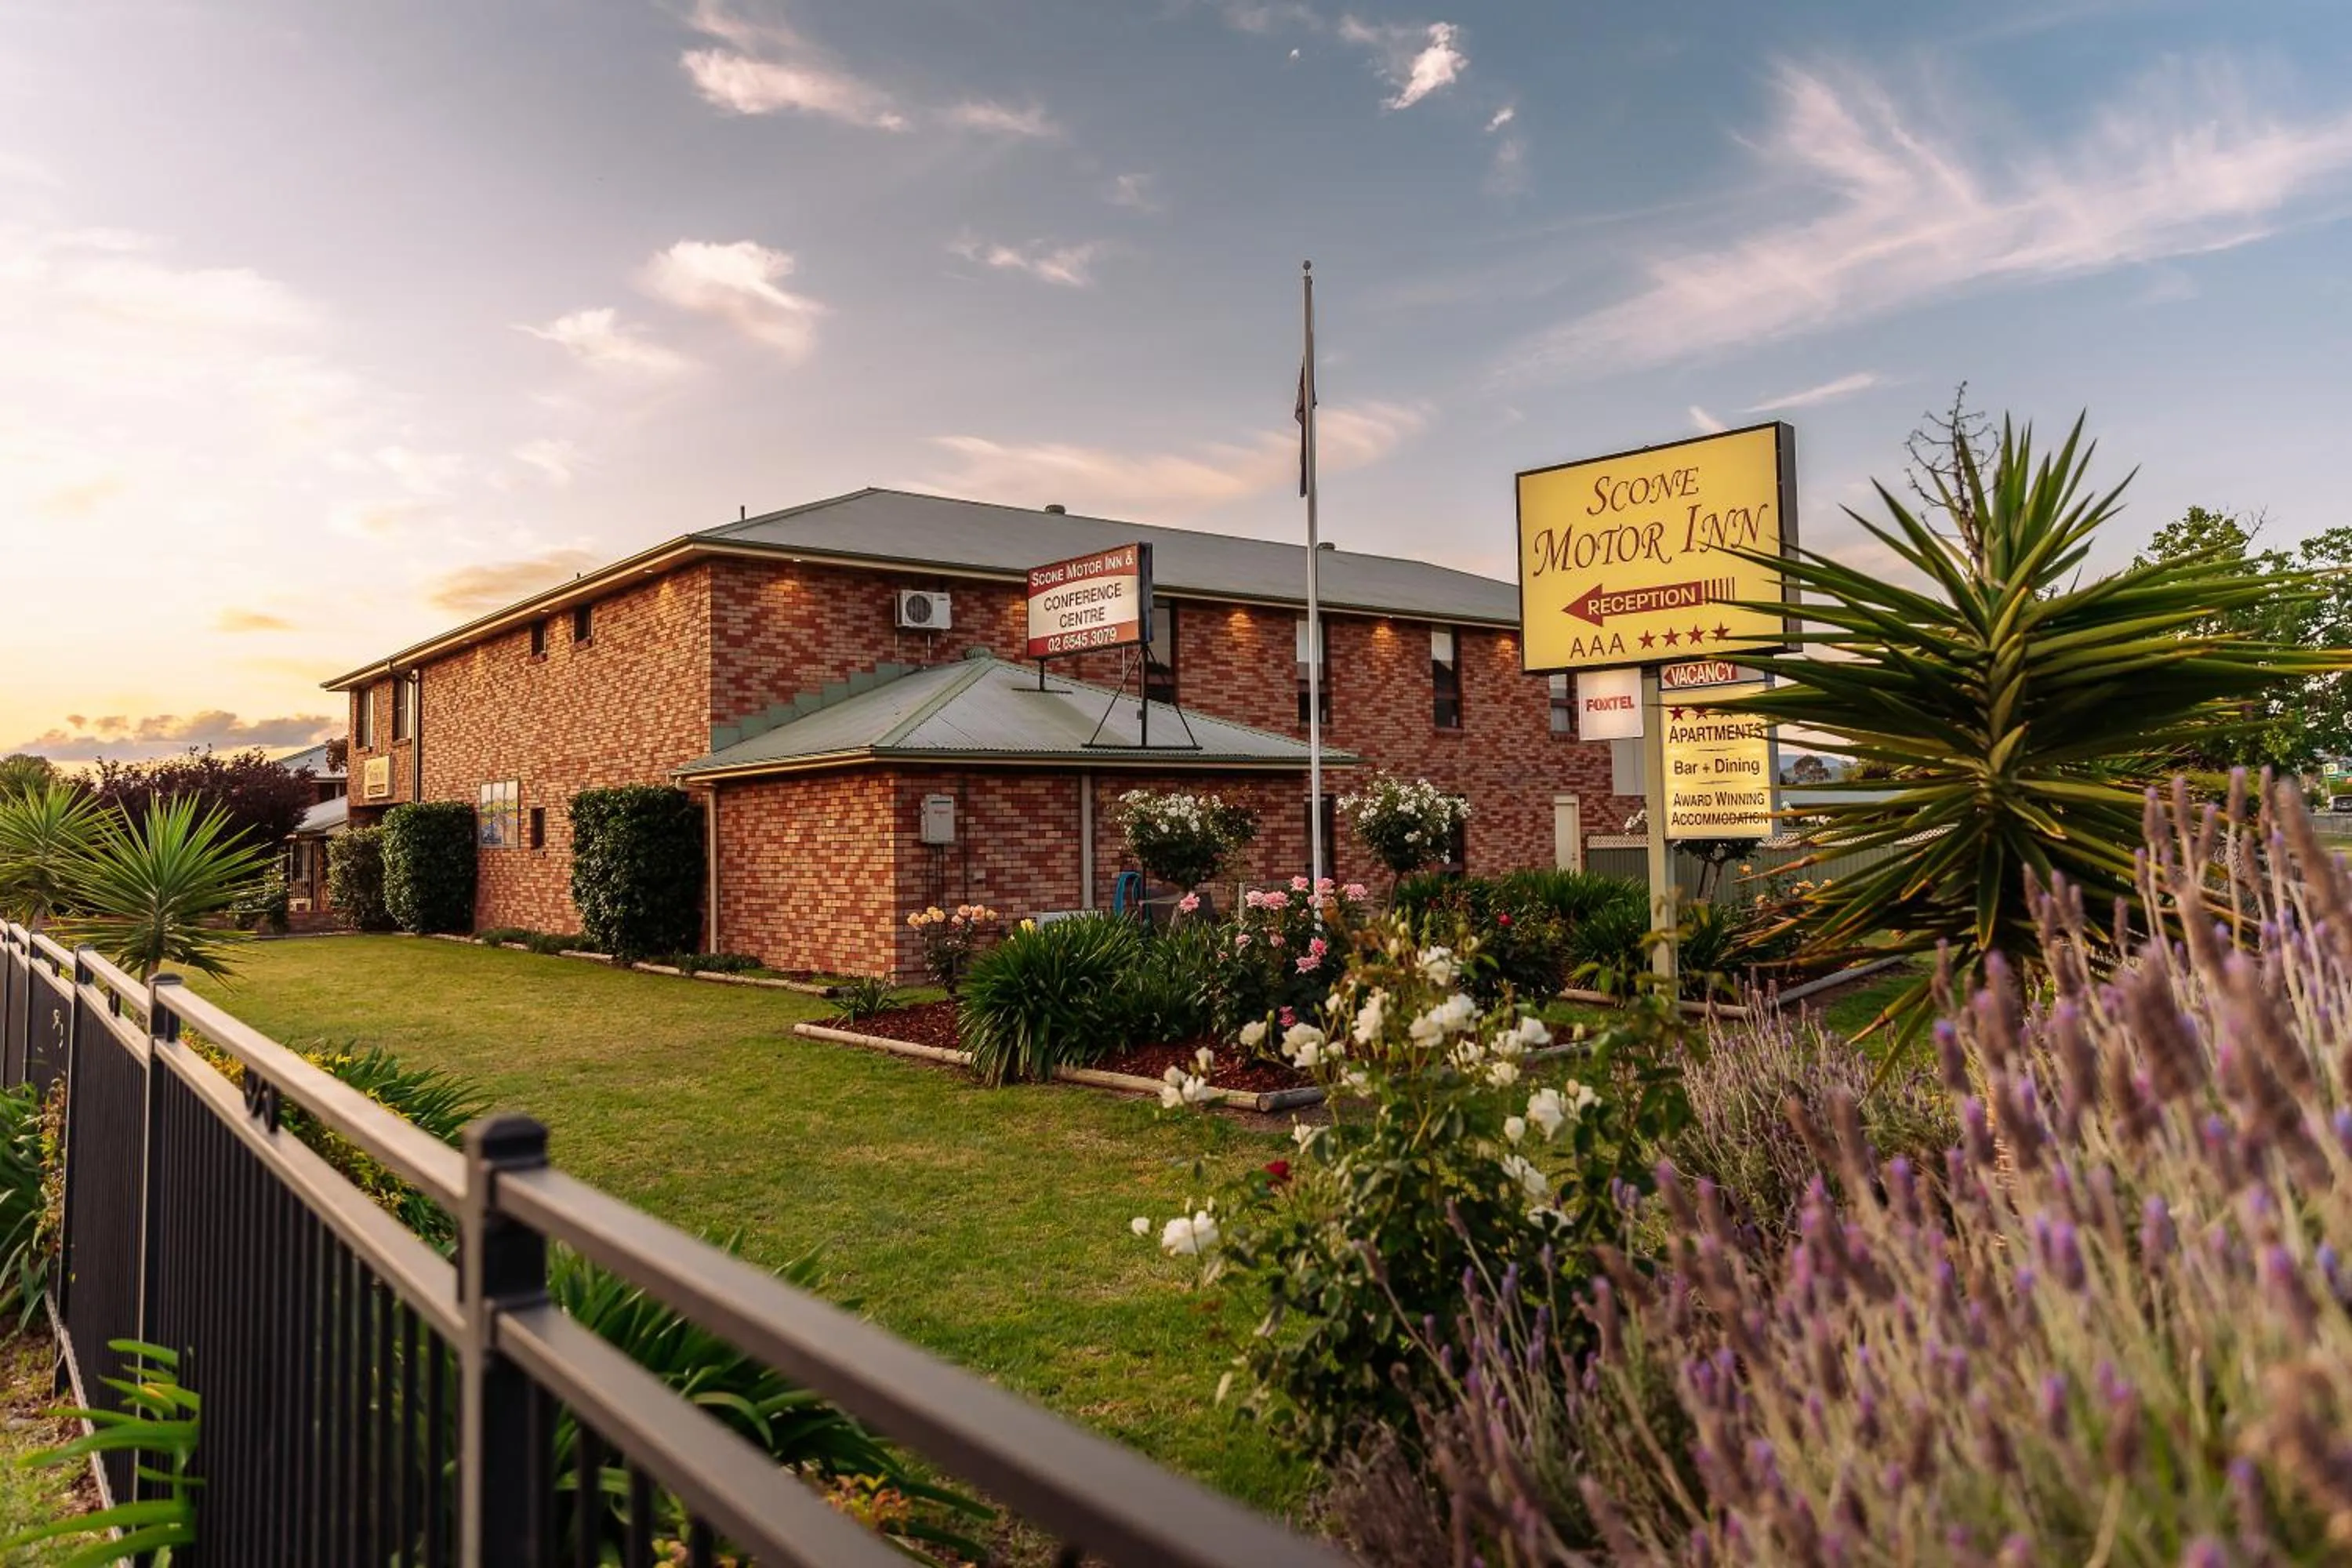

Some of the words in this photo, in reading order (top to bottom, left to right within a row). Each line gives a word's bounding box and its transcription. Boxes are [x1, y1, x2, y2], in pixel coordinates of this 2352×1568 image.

[1586, 467, 1700, 516] SCONE
[1533, 522, 1672, 577] MOTOR
[1679, 503, 1769, 553] INN
[1031, 570, 1064, 586] SCONE
[1067, 561, 1102, 579] MOTOR
[1105, 555, 1122, 570] INN
[1125, 550, 1134, 565] &
[1044, 583, 1123, 612] CONFERENCE
[1587, 586, 1697, 615] RECEPTION
[1059, 607, 1105, 628] CENTRE
[1048, 637, 1061, 652] 02
[1062, 633, 1088, 650] 6545
[1091, 627, 1117, 644] 3079
[1570, 633, 1625, 659] AAA
[1671, 662, 1733, 686] VACANCY
[1586, 695, 1635, 712] FOXTEL
[1668, 722, 1763, 743] APARTMENTS
[1674, 760, 1698, 775] Bar
[1703, 764, 1711, 774] +
[1715, 757, 1760, 775] Dining
[1673, 793, 1712, 807] AWARD
[1715, 791, 1764, 806] WINNING
[1671, 811, 1768, 826] ACCOMMODATION
